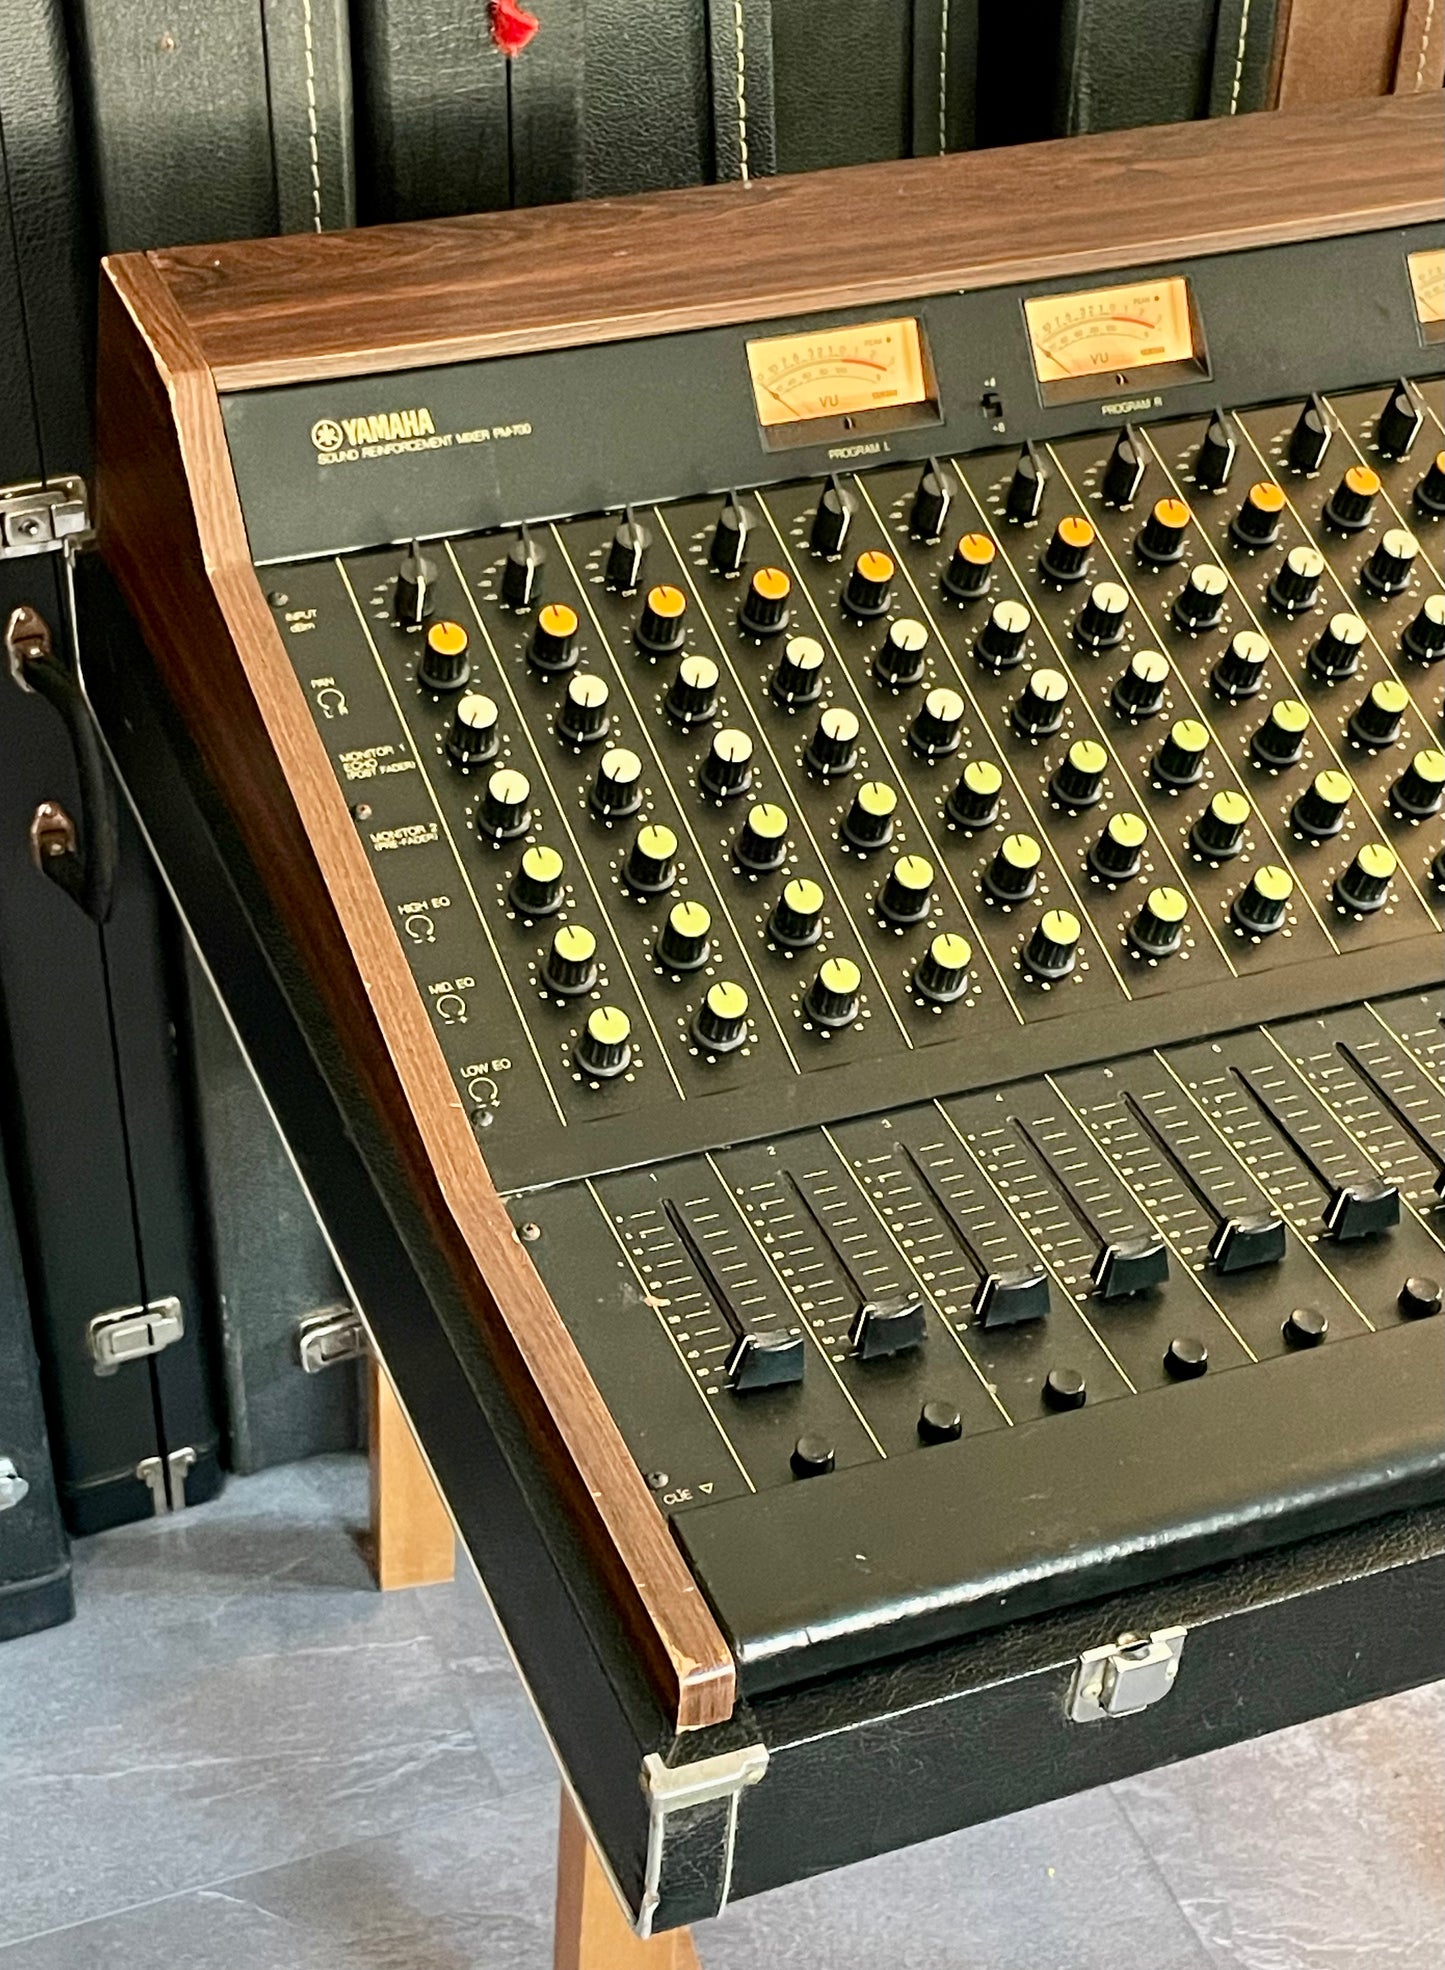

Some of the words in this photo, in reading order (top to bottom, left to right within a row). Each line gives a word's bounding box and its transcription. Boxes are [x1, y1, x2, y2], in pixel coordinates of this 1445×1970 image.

[1090, 352, 1109, 365] VU
[819, 394, 839, 408] VU
[1101, 398, 1151, 415] PROGRAM
[342, 407, 436, 446] YAMAHA
[317, 449, 360, 466] SOUND
[362, 434, 453, 458] REINFORCEMENT
[455, 428, 490, 445] MIXER
[828, 442, 880, 460] PROGRAM
[883, 441, 891, 452] L
[338, 745, 395, 763] MONITOR
[369, 825, 427, 843] MONITOR
[397, 901, 429, 915] HIGH
[460, 1063, 489, 1079] LOW
[766, 1145, 777, 1156] 2
[663, 1488, 694, 1506] CUE
